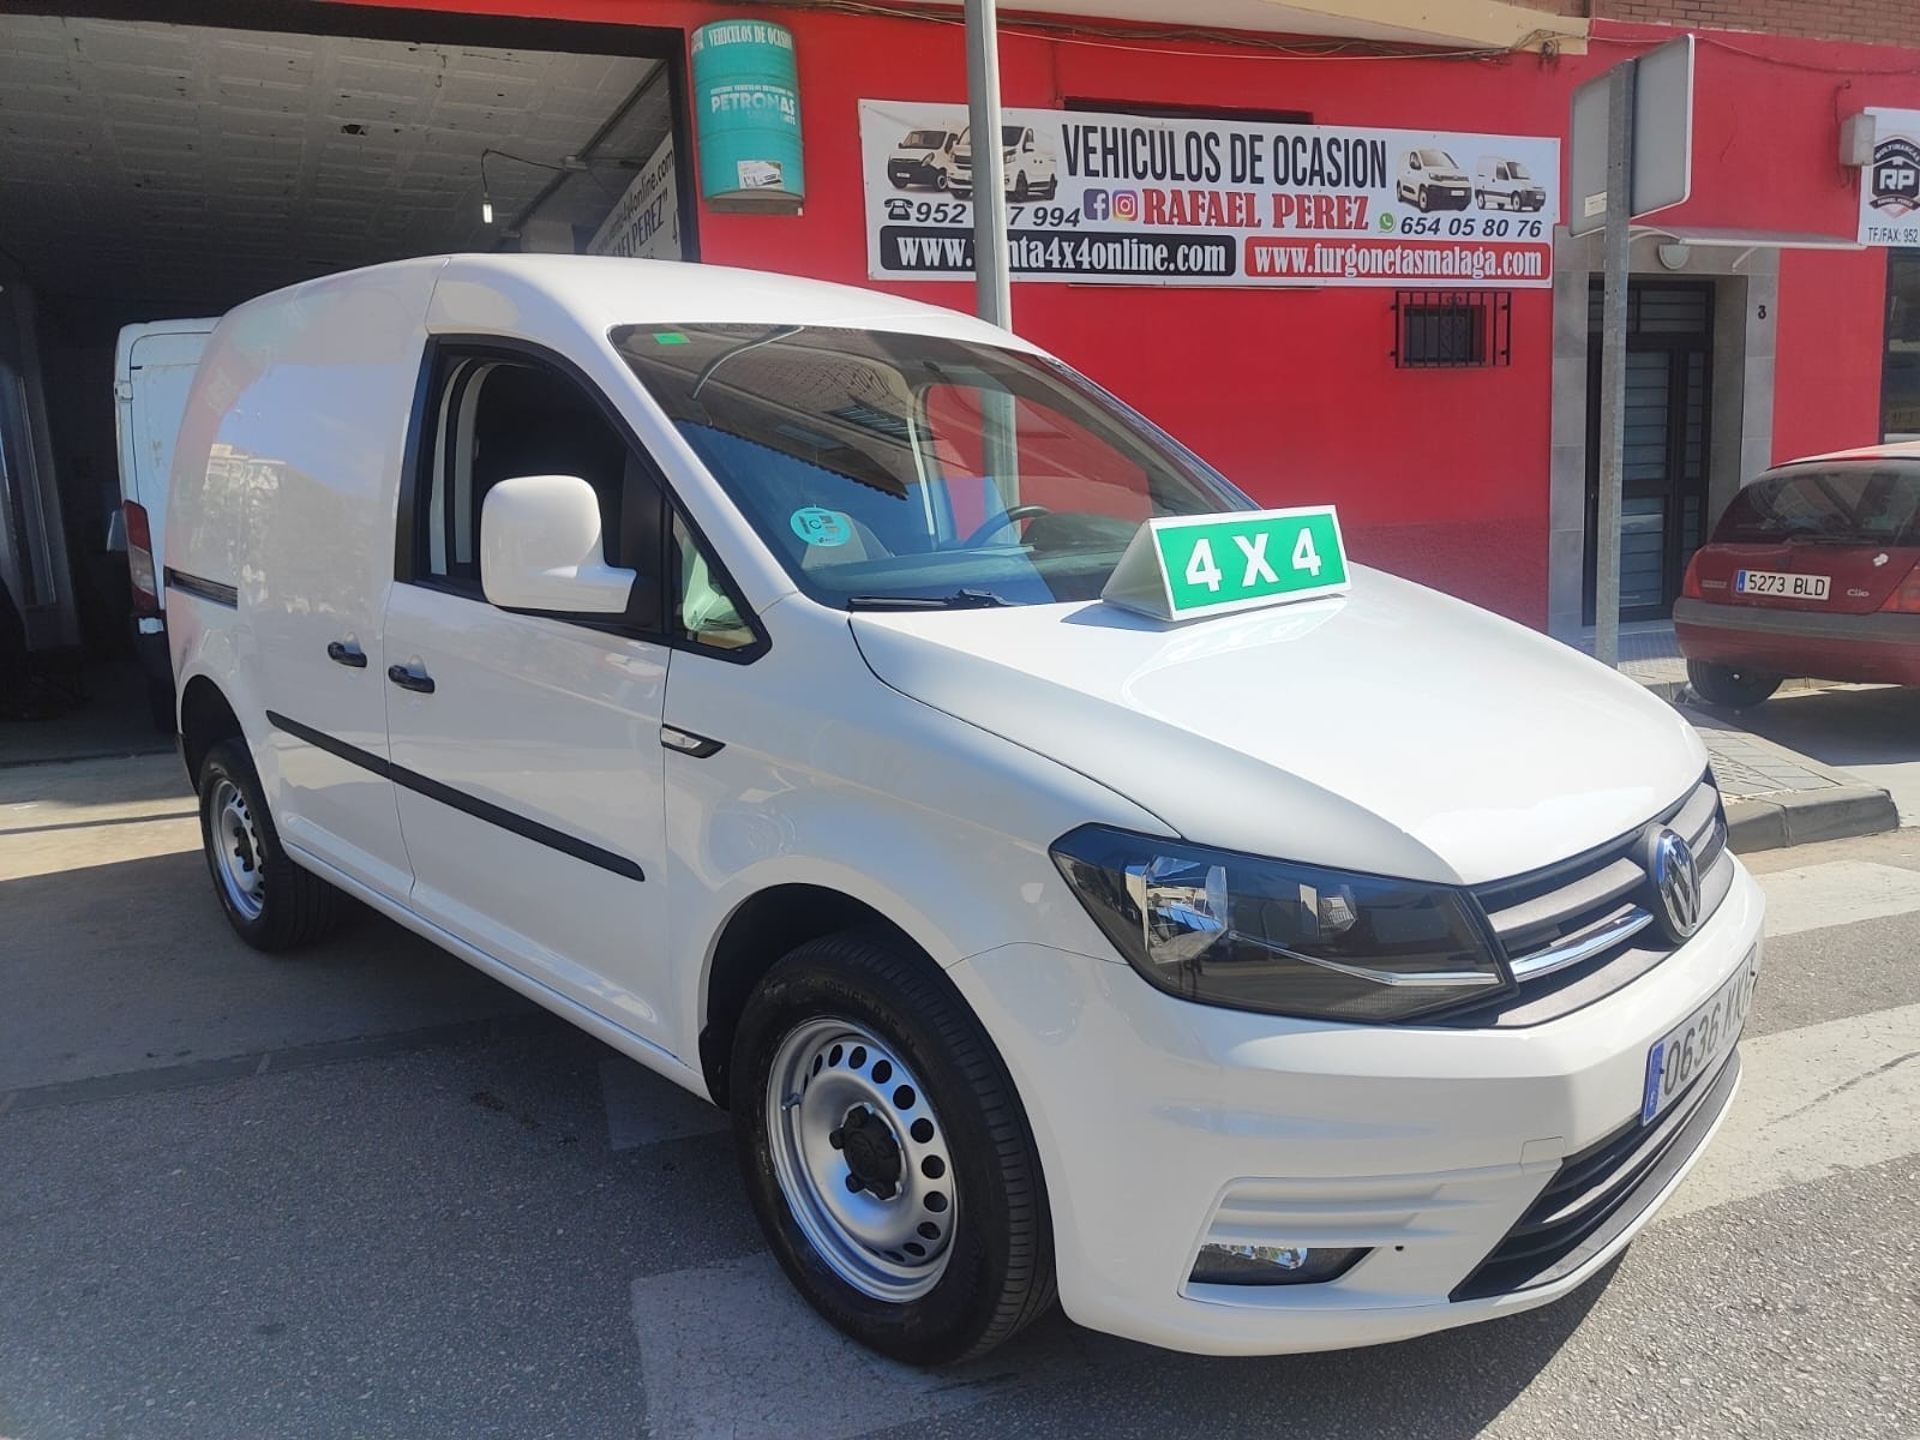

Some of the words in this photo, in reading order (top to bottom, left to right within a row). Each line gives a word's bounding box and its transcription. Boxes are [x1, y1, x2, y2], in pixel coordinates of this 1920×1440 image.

[755, 26, 766, 43] DE
[711, 93, 796, 116] PETRONAS
[1061, 123, 1221, 183] VEHICULOS
[1230, 133, 1264, 184] DE
[1272, 135, 1387, 188] OCASION
[915, 202, 967, 224] 952
[1033, 206, 1081, 228] 994
[1142, 188, 1261, 228] RAFAEL
[1272, 193, 1369, 230] PEREZ
[1401, 216, 1441, 235] 654
[1449, 218, 1475, 236] 05
[1482, 218, 1508, 237] 80
[1516, 219, 1542, 238] 76
[898, 235, 1226, 272] www.nta4x4online.com
[1254, 243, 1542, 279] www.furgonetasmalaga.com
[1185, 538, 1223, 592] 4
[1232, 532, 1280, 587] X
[1291, 527, 1322, 576] 4
[1748, 574, 1785, 594] 5273
[1793, 577, 1825, 596] BLD
[1663, 1002, 1721, 1096] 0636
